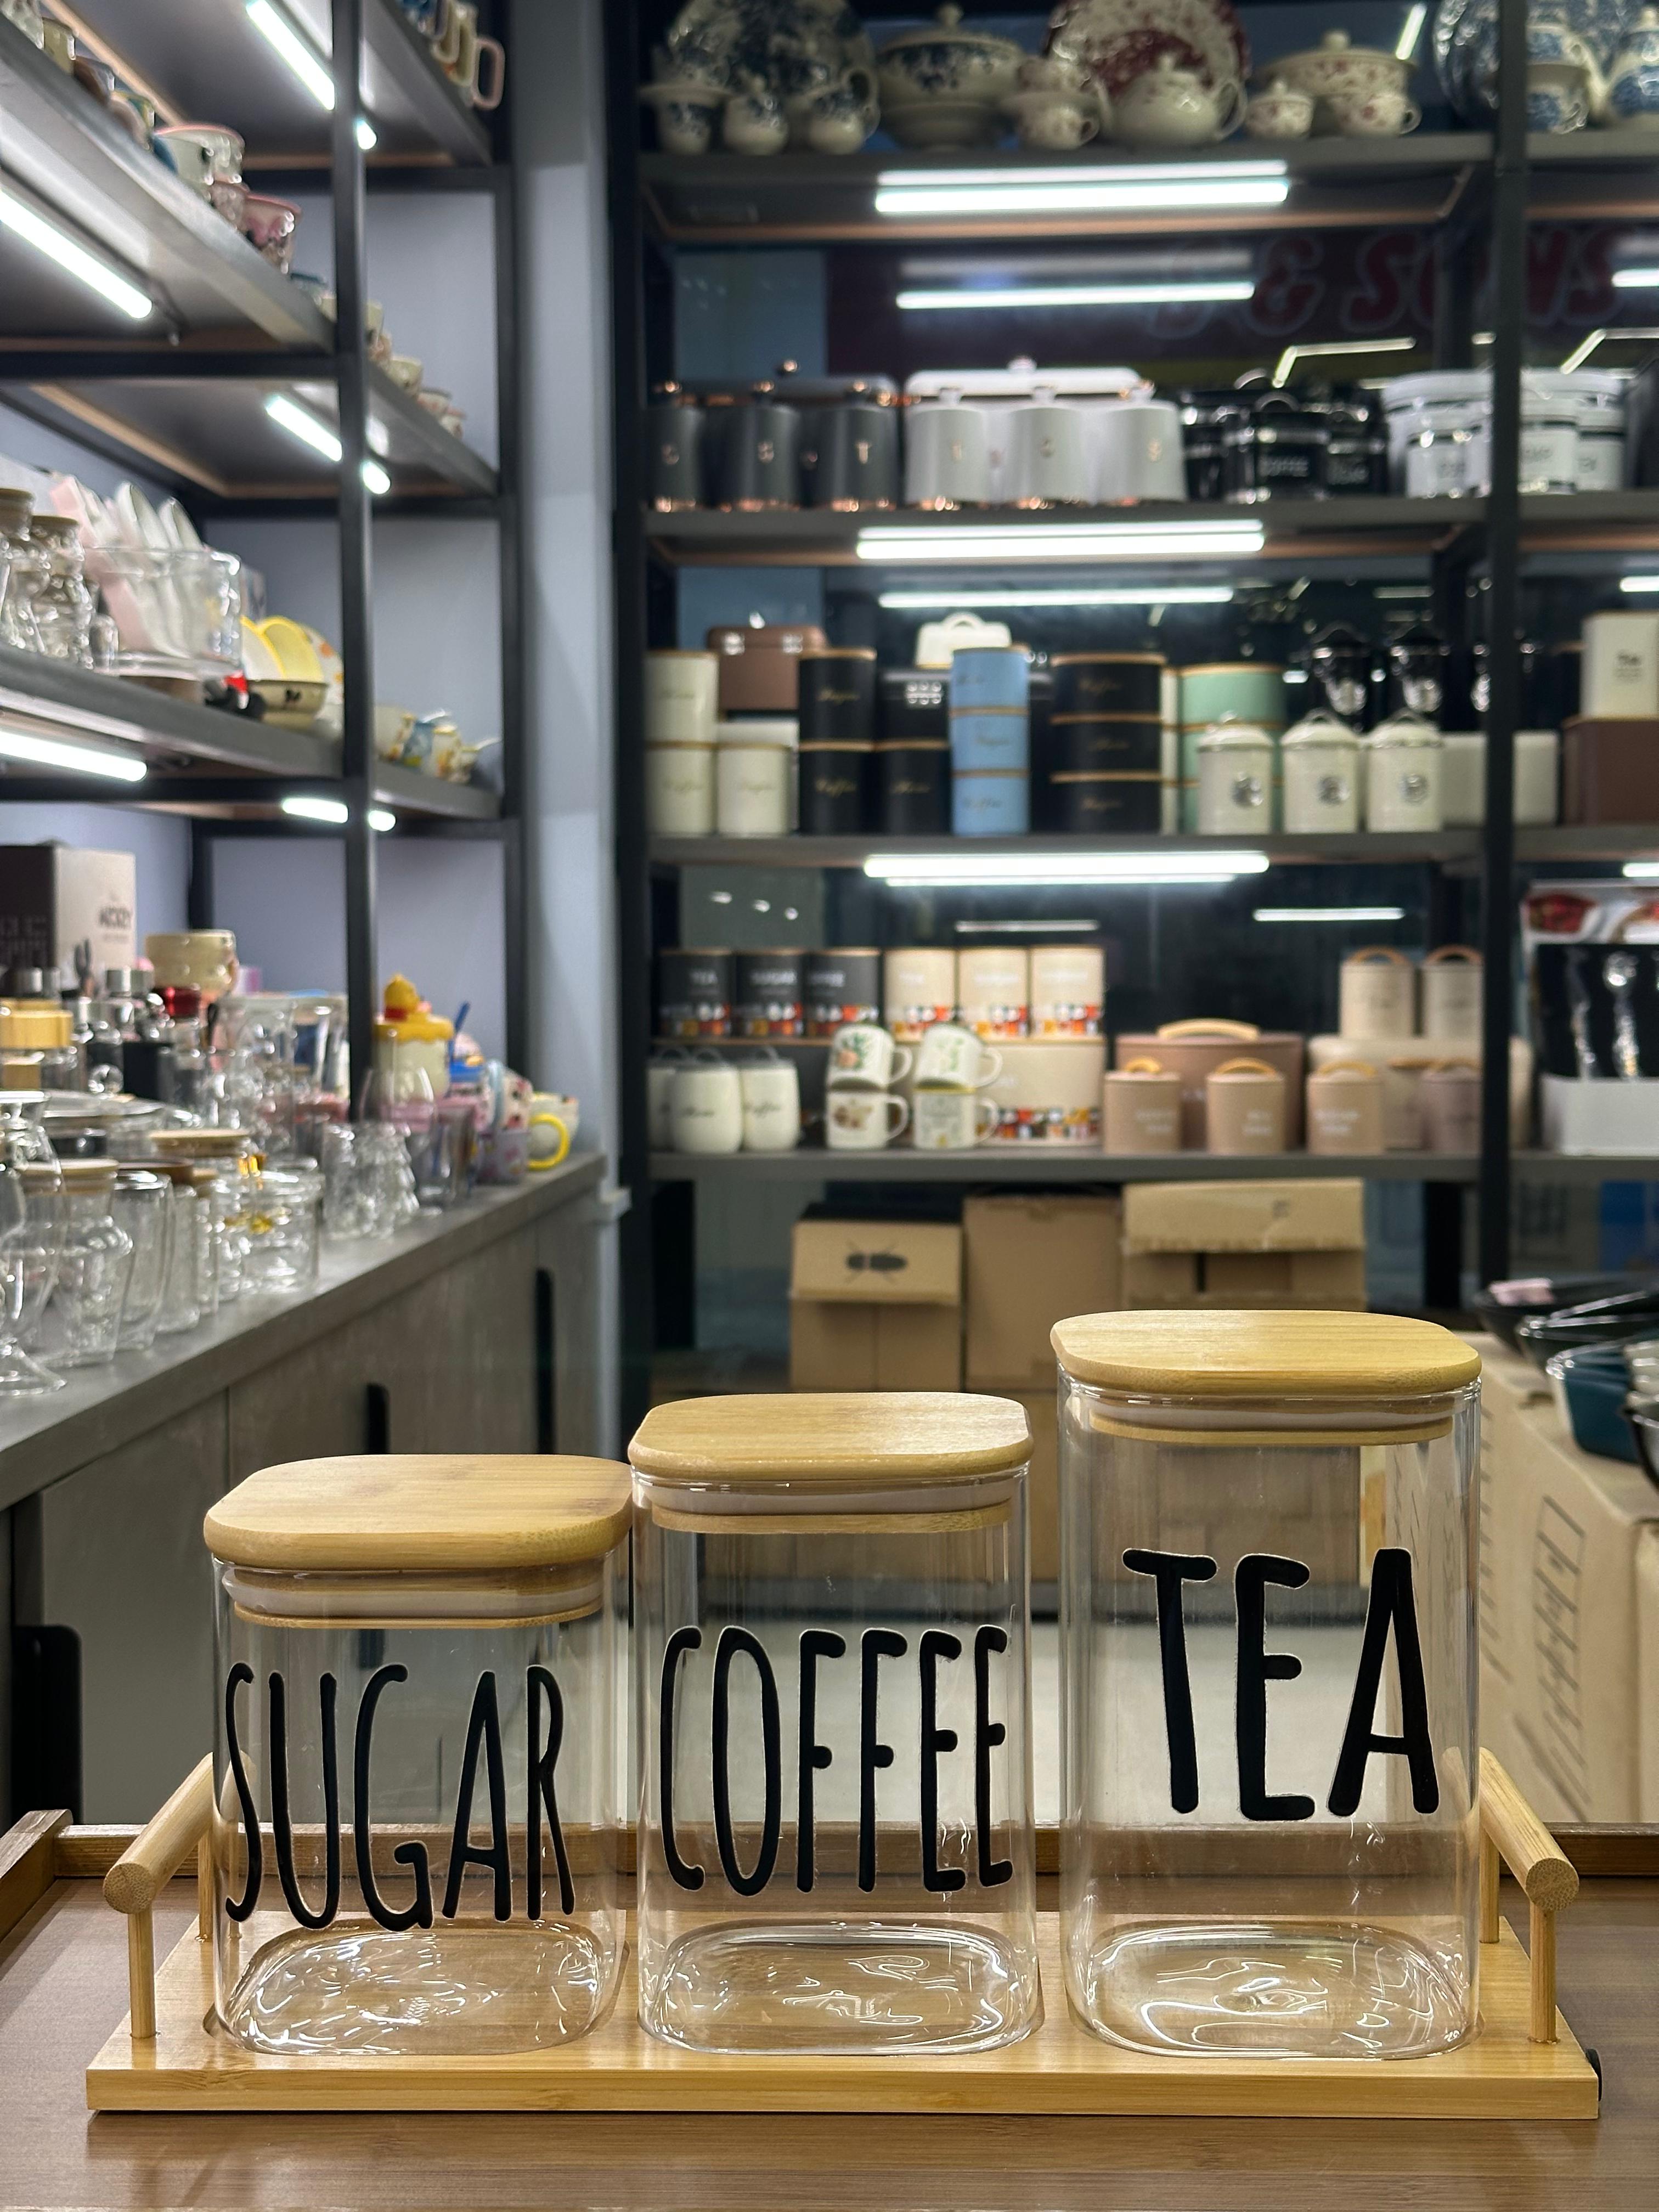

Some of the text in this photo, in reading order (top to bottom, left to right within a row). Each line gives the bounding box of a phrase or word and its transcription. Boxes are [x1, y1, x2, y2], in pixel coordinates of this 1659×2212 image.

[225, 1663, 575, 1931] SUGAR
[660, 1626, 1013, 1896] COFFEE
[1122, 1548, 1440, 1821] TEA
